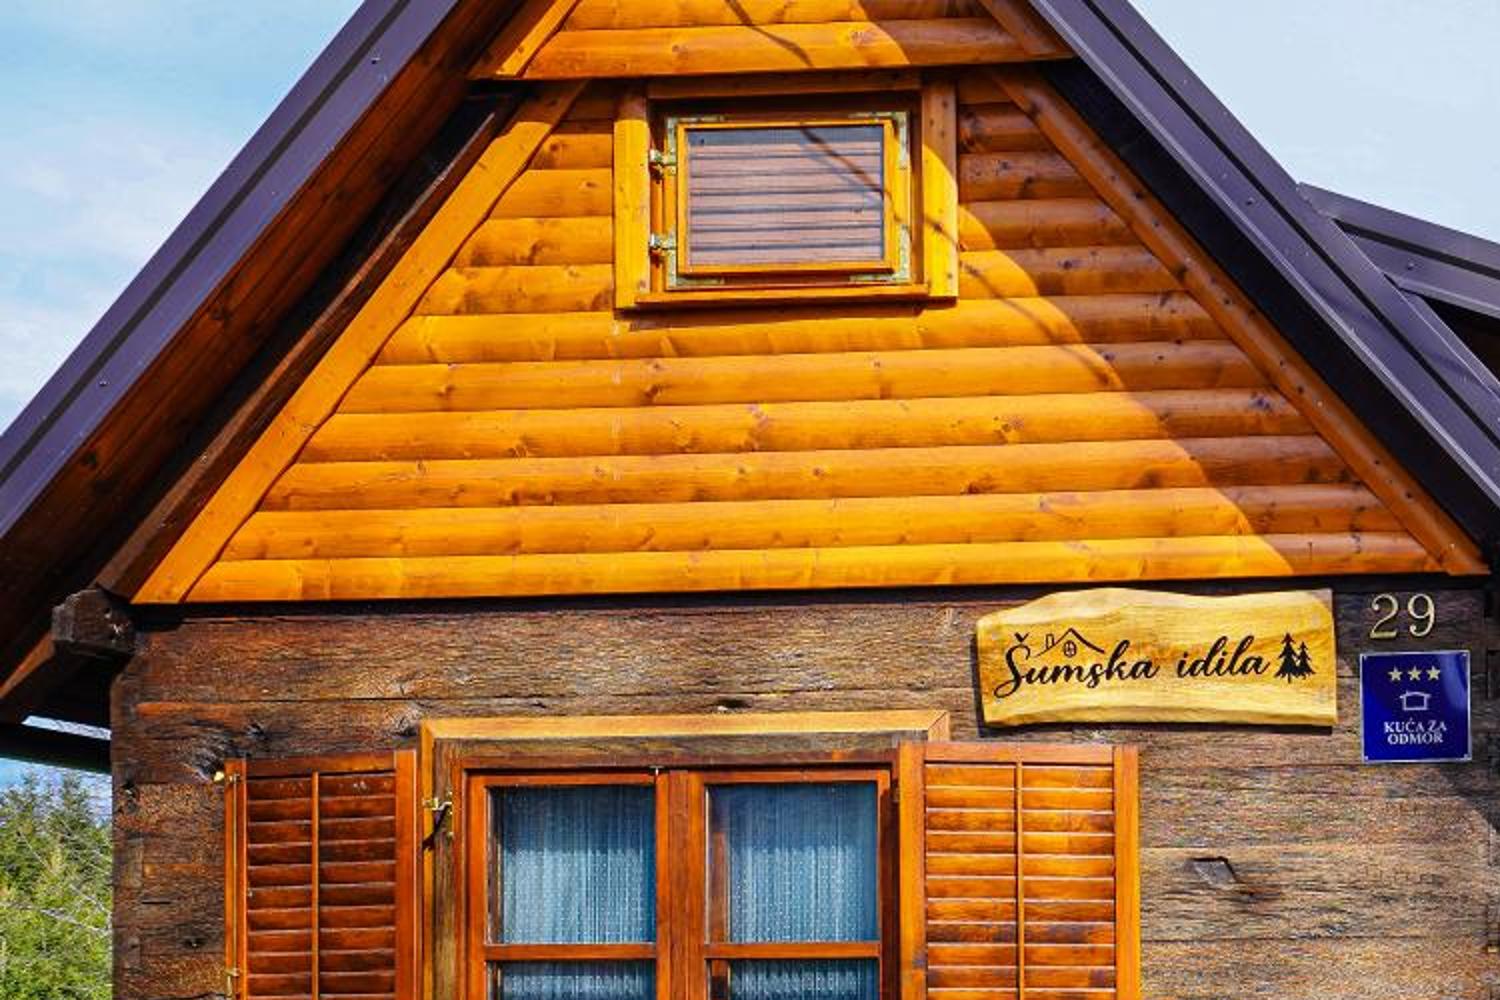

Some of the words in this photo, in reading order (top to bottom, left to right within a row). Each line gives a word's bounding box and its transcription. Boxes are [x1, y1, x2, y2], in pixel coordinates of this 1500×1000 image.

[1370, 593, 1435, 638] 29
[994, 632, 1159, 698] Šumska
[1176, 635, 1270, 679] idila
[1384, 717, 1425, 733] KUĆA
[1427, 720, 1447, 732] ZA
[1387, 732, 1443, 745] ODMOR
